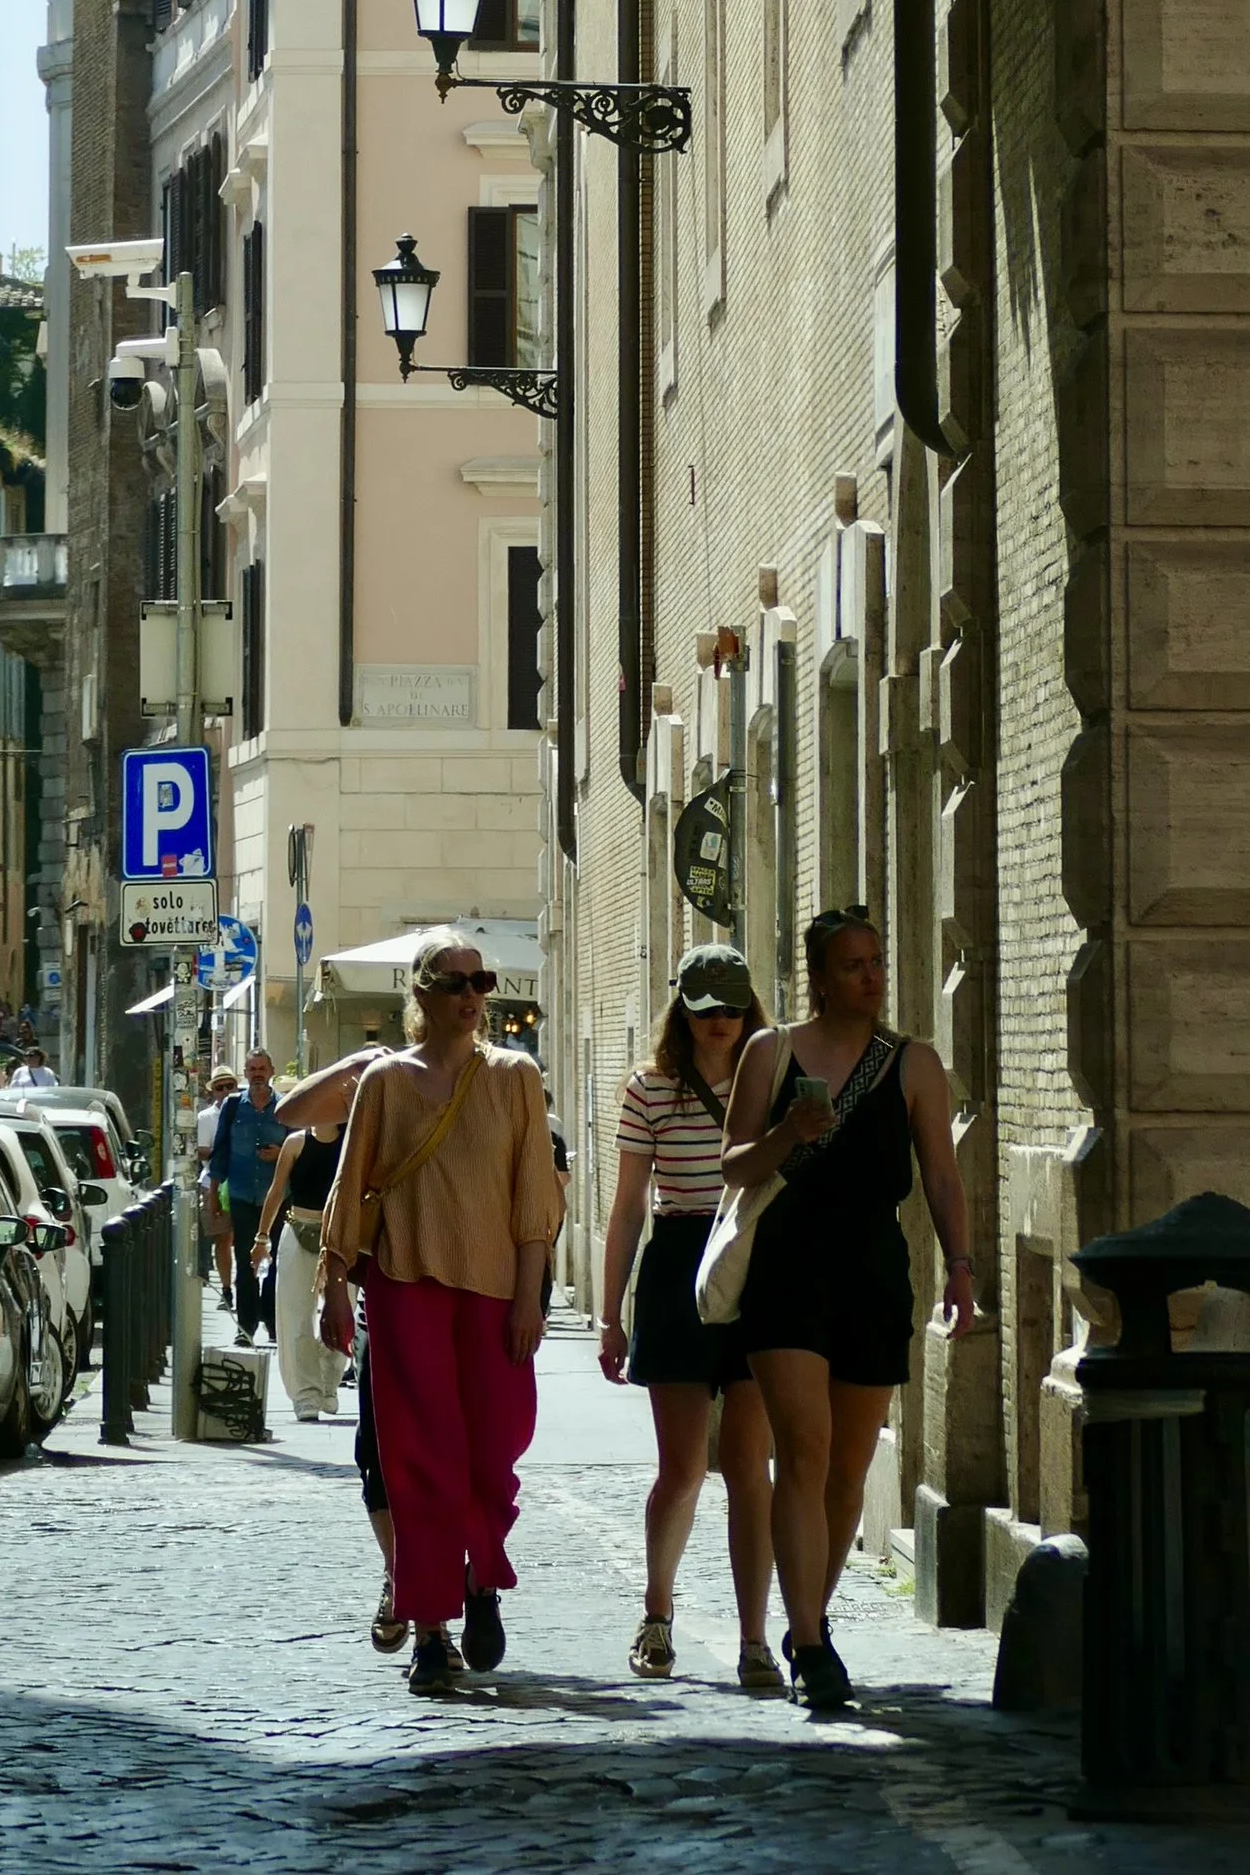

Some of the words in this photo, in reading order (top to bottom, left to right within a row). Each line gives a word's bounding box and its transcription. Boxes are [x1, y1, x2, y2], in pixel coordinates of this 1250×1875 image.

[390, 675, 442, 689] PIAZZA
[376, 703, 469, 717] APOLLINARE
[142, 762, 195, 867] P
[153, 891, 184, 909] solo
